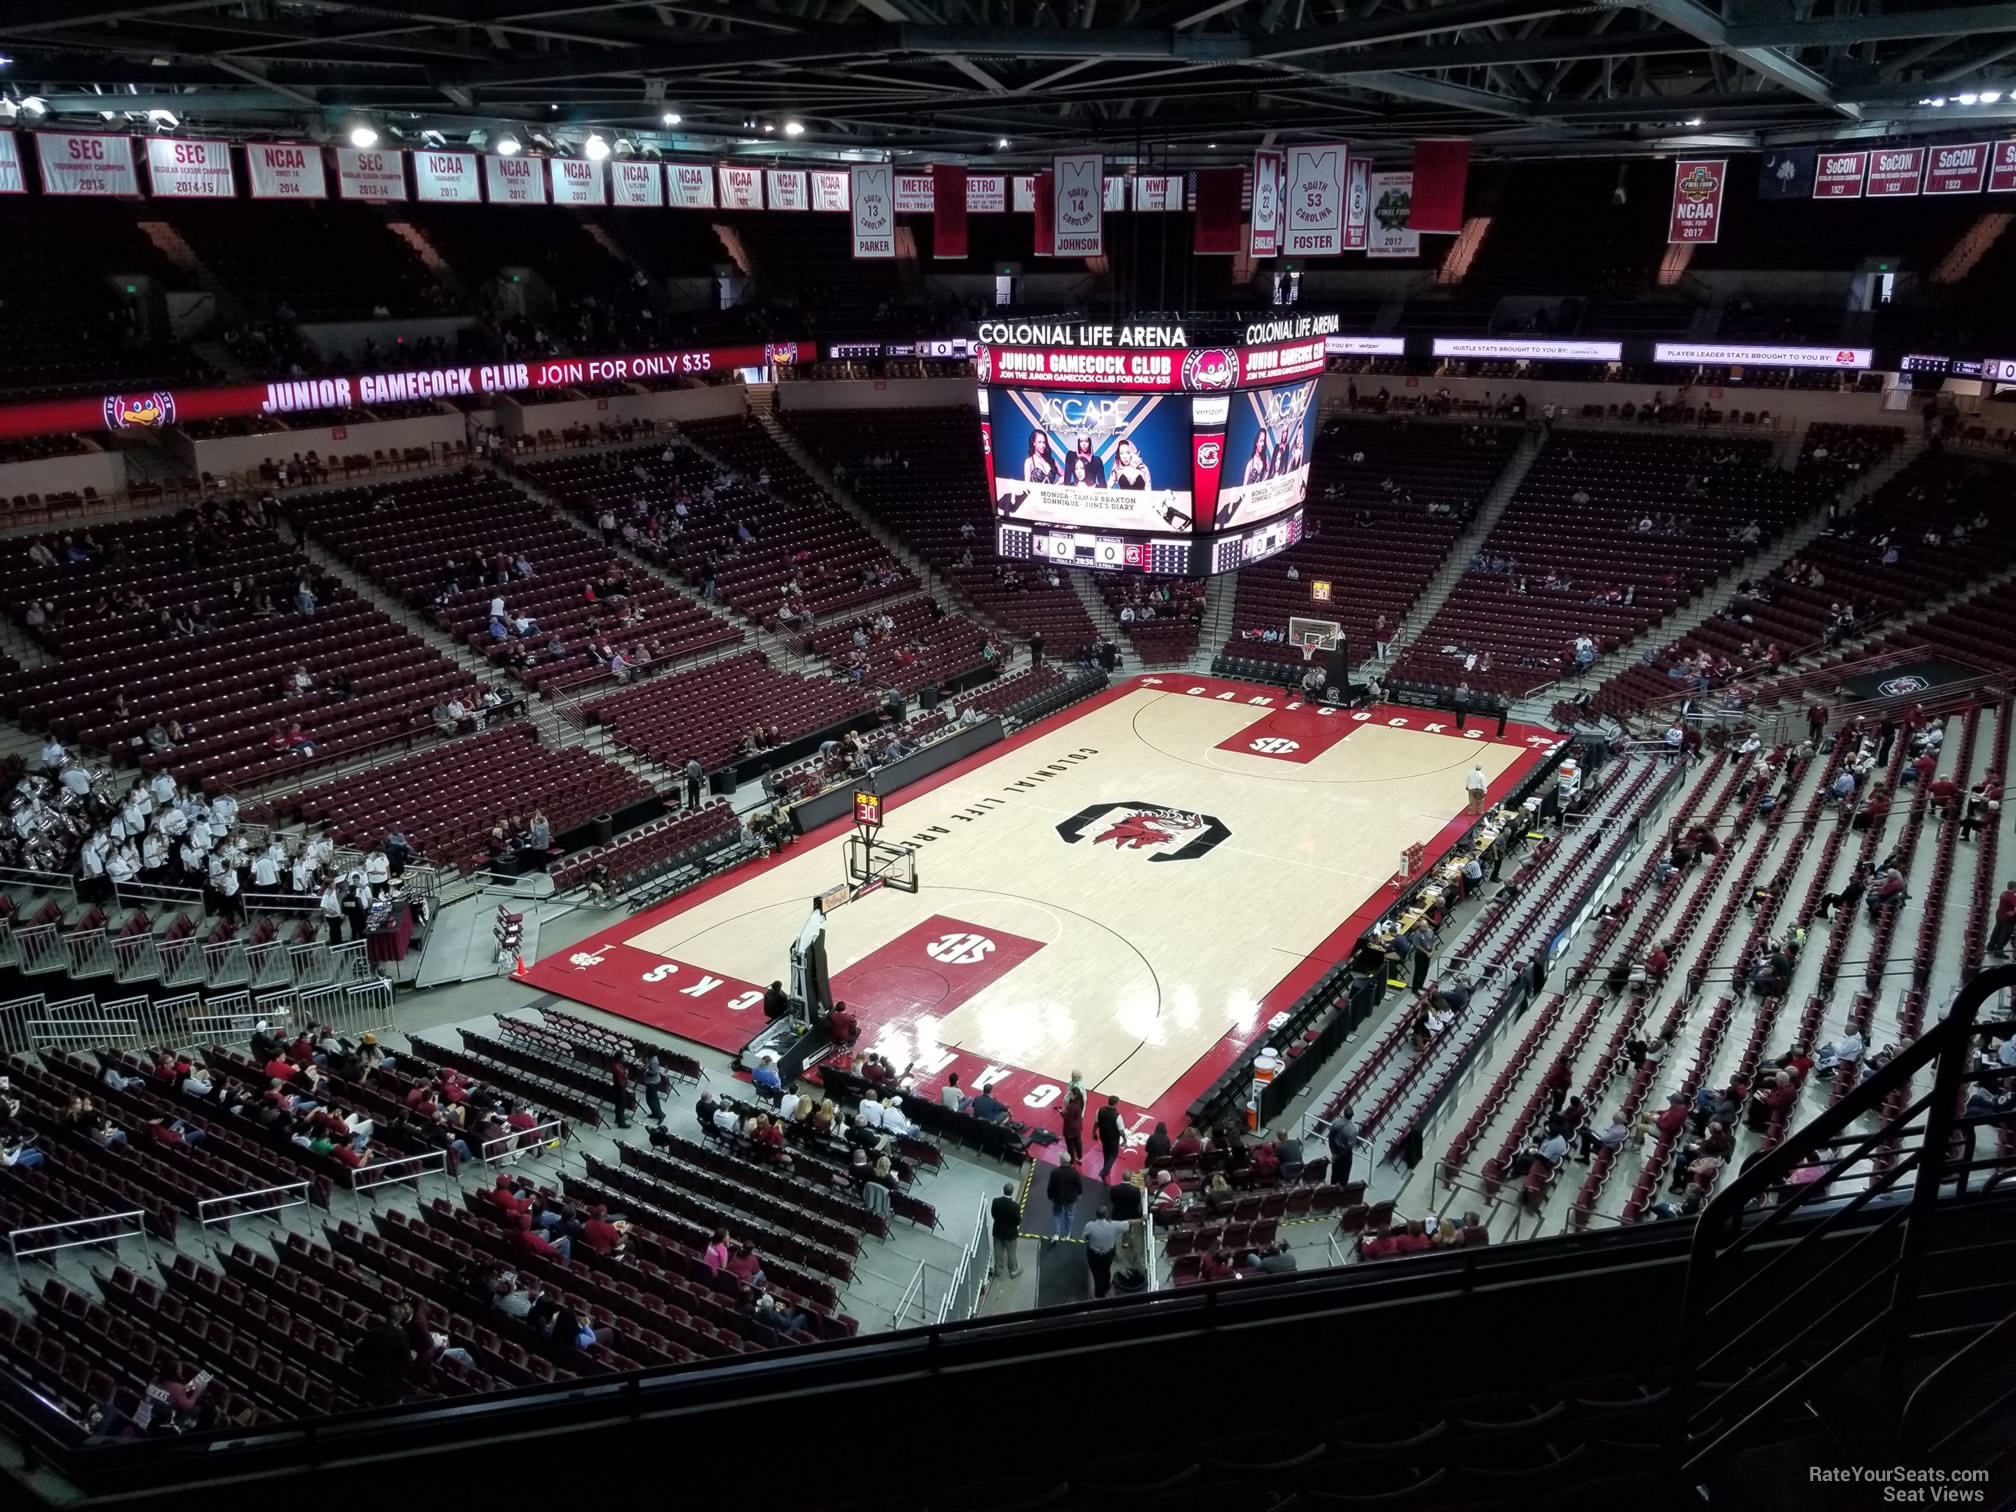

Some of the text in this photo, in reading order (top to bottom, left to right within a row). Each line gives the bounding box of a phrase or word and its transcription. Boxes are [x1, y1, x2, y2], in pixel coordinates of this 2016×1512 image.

[69, 139, 103, 160] SEC
[175, 144, 206, 164] SEC
[265, 149, 305, 168] NCAA
[359, 154, 383, 171] SEC
[429, 156, 463, 173] NCAA
[1879, 154, 1913, 171] SoCON
[1939, 149, 1976, 168] SoCON
[154, 166, 178, 174] REGULAR
[500, 160, 530, 177] NCAA
[564, 162, 592, 179] NCAA
[1826, 158, 1857, 174] SoCON
[624, 166, 649, 181] NCAA
[679, 168, 703, 184] NCAA
[730, 172, 752, 186] NCAA
[80, 179, 105, 190] 2015
[177, 182, 213, 193] 2014-15
[777, 174, 798, 188] NCAA
[821, 176, 840, 190] NCAA
[1302, 181, 1328, 194] SOUTH
[1886, 183, 1900, 192] 1933
[1945, 180, 1961, 190] 1933
[280, 183, 299, 193] 2014
[359, 185, 388, 195] 2013-14
[441, 188, 458, 197] 2013
[510, 190, 526, 199] 2012
[1067, 188, 1089, 199] SOUTH
[1831, 185, 1844, 194] 1927
[573, 192, 587, 200] 2003
[632, 194, 646, 202] 2002
[686, 196, 698, 204] 1991
[864, 193, 882, 205] SOUTH
[1263, 196, 1269, 208] 22
[1308, 194, 1322, 206] 53
[868, 205, 879, 217] 13
[1072, 200, 1084, 212] 14
[1677, 203, 1713, 219] NCAA
[1062, 212, 1094, 226] CAROLINA
[1295, 207, 1332, 222] CAROLINA
[860, 216, 887, 230] CAROLINA
[1683, 228, 1703, 237] 2017
[860, 241, 889, 252] PARKER
[1058, 238, 1098, 250] JOHNSON
[1293, 235, 1332, 249] FOSTER
[1385, 238, 1402, 246] 2017
[979, 324, 1188, 347] COLONIAL LIFE ARENA
[1246, 314, 1339, 345] COLONIAL LIFE ARENA
[938, 344, 946, 354] 0
[999, 352, 1171, 375] JUNIOR GAMECOCK CLUB
[1246, 351, 1278, 371] JUNIOR
[999, 371, 1171, 384] JOIN THE JUNIOR GAMECOCK CLUB FOR ONLY $35
[2006, 365, 2015, 378] 0
[263, 353, 711, 412] JUNIOR GAMECOCK CLUB JOIN FOR ONLY $35
[1265, 387, 1309, 419] XSCAPE
[1039, 398, 1129, 427] XSCAPE
[1040, 490, 1069, 499] MONICA
[1074, 494, 1099, 502] TAMAR
[1101, 495, 1136, 504] BRAXTON
[1043, 497, 1079, 507] ZONNIQUE
[1085, 501, 1109, 509] JUNE'S
[1057, 542, 1066, 555] 0
[1257, 539, 1263, 552] 0
[1105, 547, 1115, 560] 0
[1076, 558, 1094, 566] 28:36
[1314, 589, 1329, 600] 30
[1186, 687, 1484, 739] GAMECOCKS
[1249, 737, 1300, 754] SEC
[1003, 747, 1099, 793] COLONIAL
[857, 794, 878, 806] 28:36
[861, 804, 878, 822] 30
[950, 797, 1006, 822] LIFE
[926, 933, 996, 964] SEC
